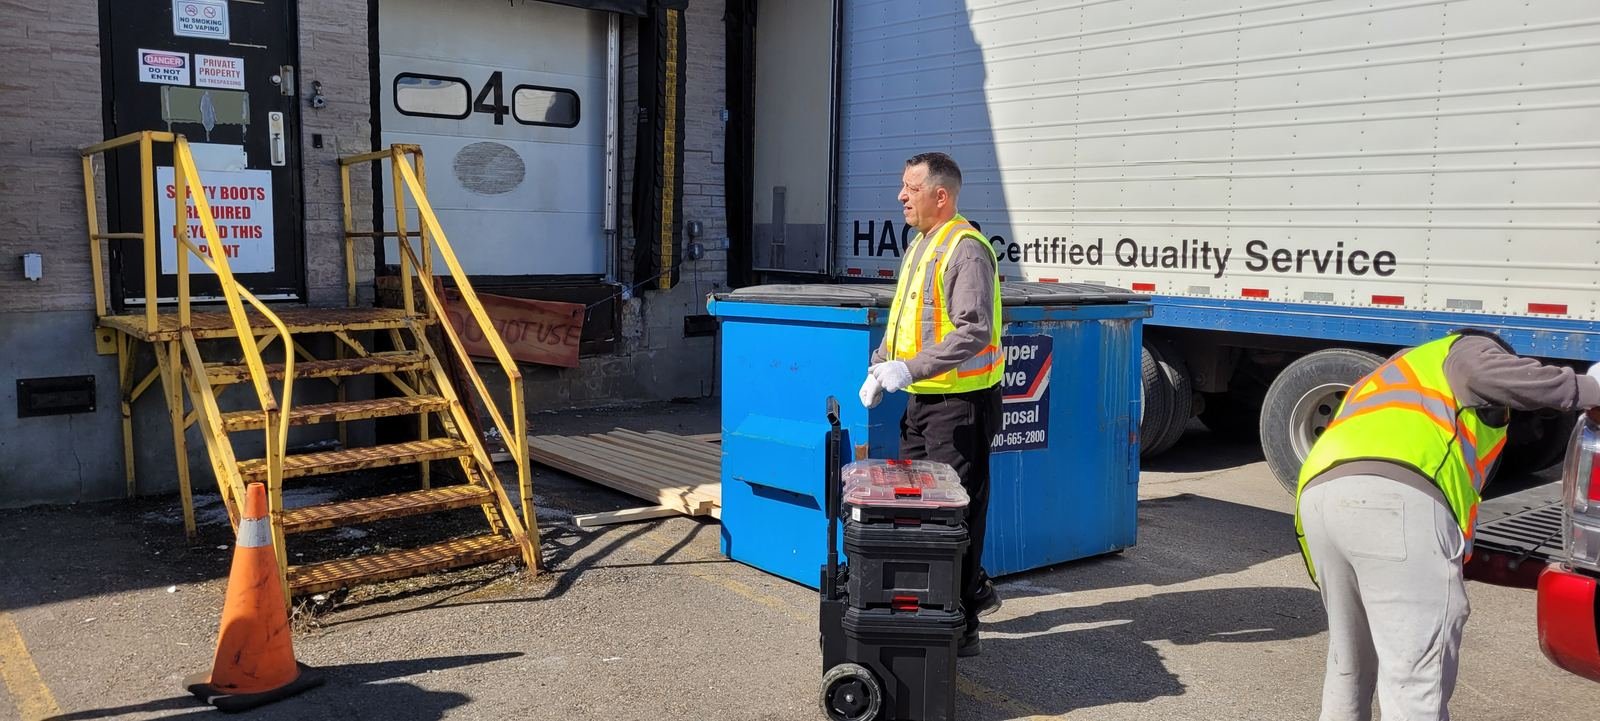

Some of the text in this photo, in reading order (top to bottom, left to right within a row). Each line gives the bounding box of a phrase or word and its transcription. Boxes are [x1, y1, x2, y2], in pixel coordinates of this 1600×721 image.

[192, 18, 222, 26] SMOKING
[147, 55, 181, 66] DANGER
[203, 58, 236, 69] PRIVATE
[199, 67, 241, 78] PROPERTY
[473, 70, 509, 125] 4
[220, 186, 265, 201] BOOTS
[186, 205, 251, 219] REUIRED
[231, 225, 263, 238] THIS
[1115, 237, 1232, 279] Quality
[1245, 239, 1397, 277] Service
[537, 323, 582, 346] USE
